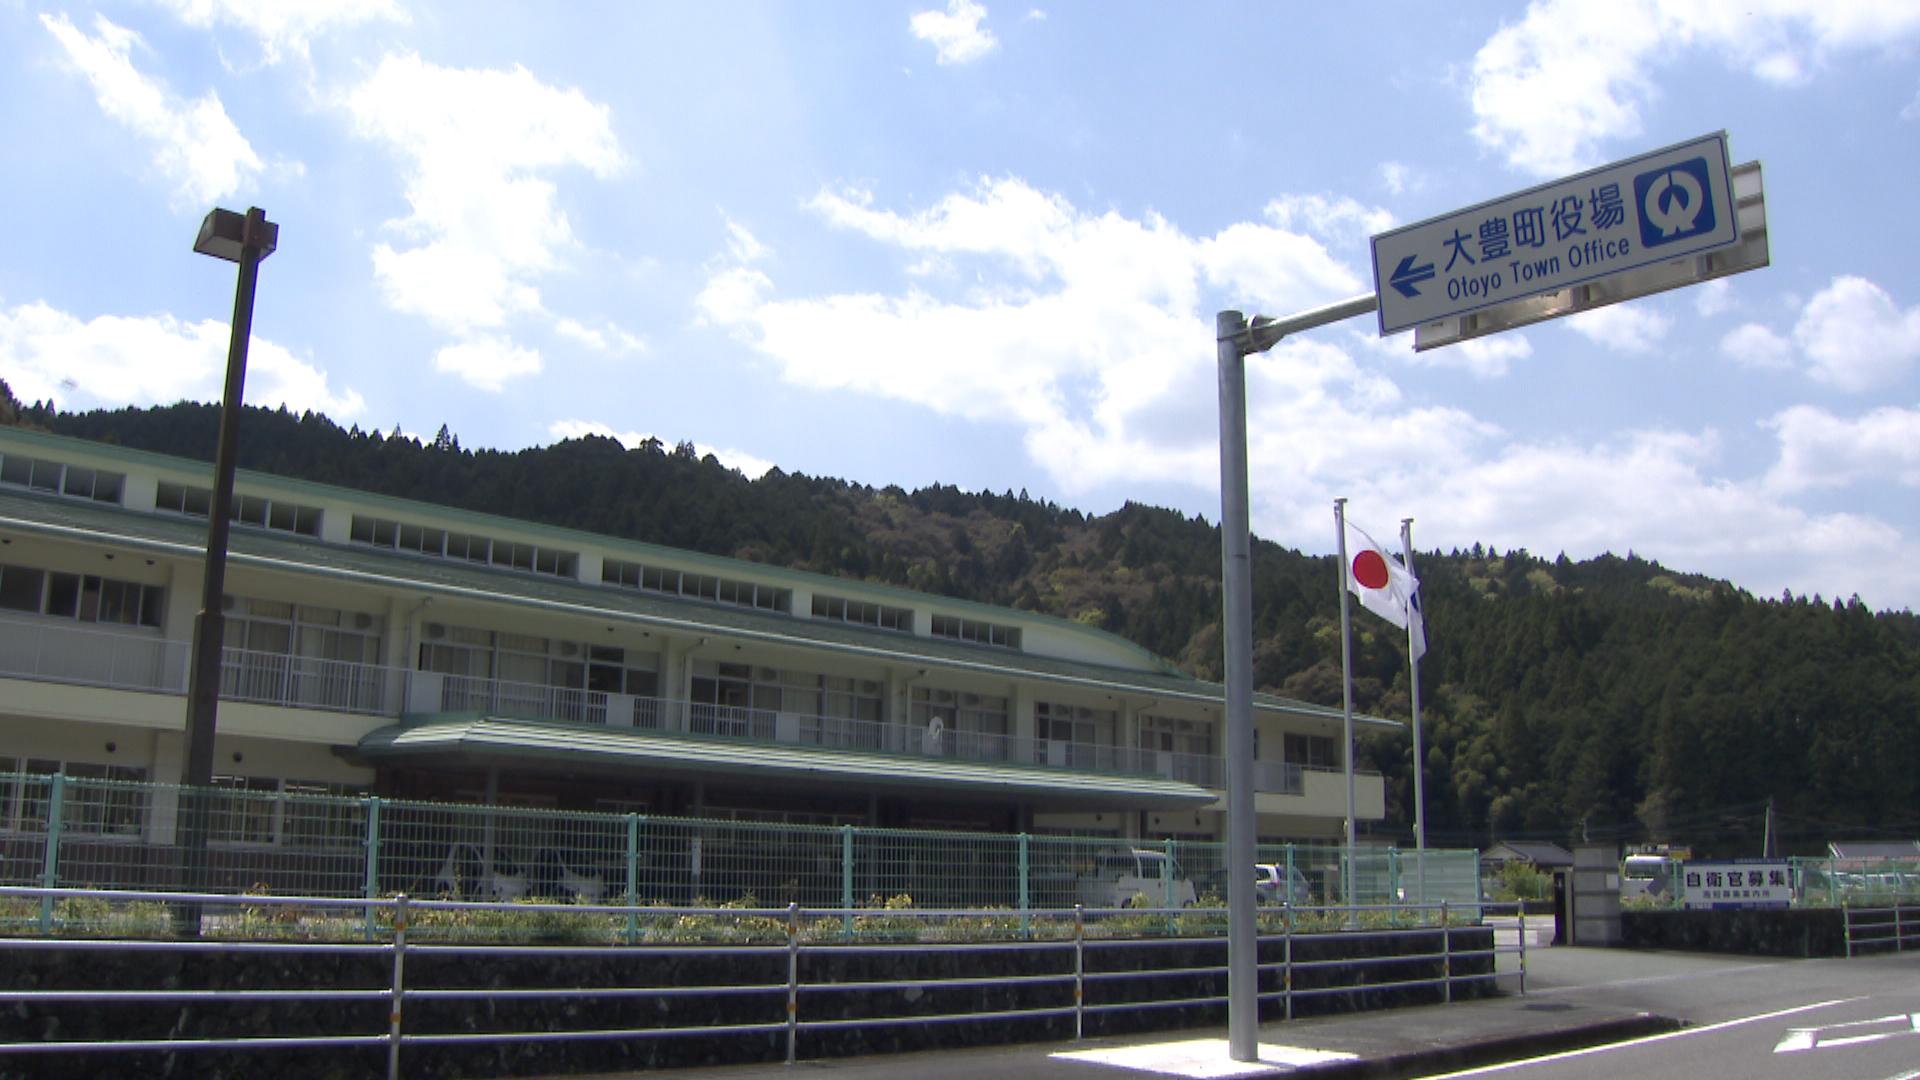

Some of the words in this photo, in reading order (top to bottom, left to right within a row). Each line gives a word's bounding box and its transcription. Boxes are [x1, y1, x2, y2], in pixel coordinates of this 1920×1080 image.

[1443, 182, 1625, 273] 大豊町役場
[1447, 272, 1502, 300] Otoyo
[1510, 255, 1560, 284] Town
[1568, 237, 1630, 268] Office
[1687, 870, 1785, 888] 自衛官募集
